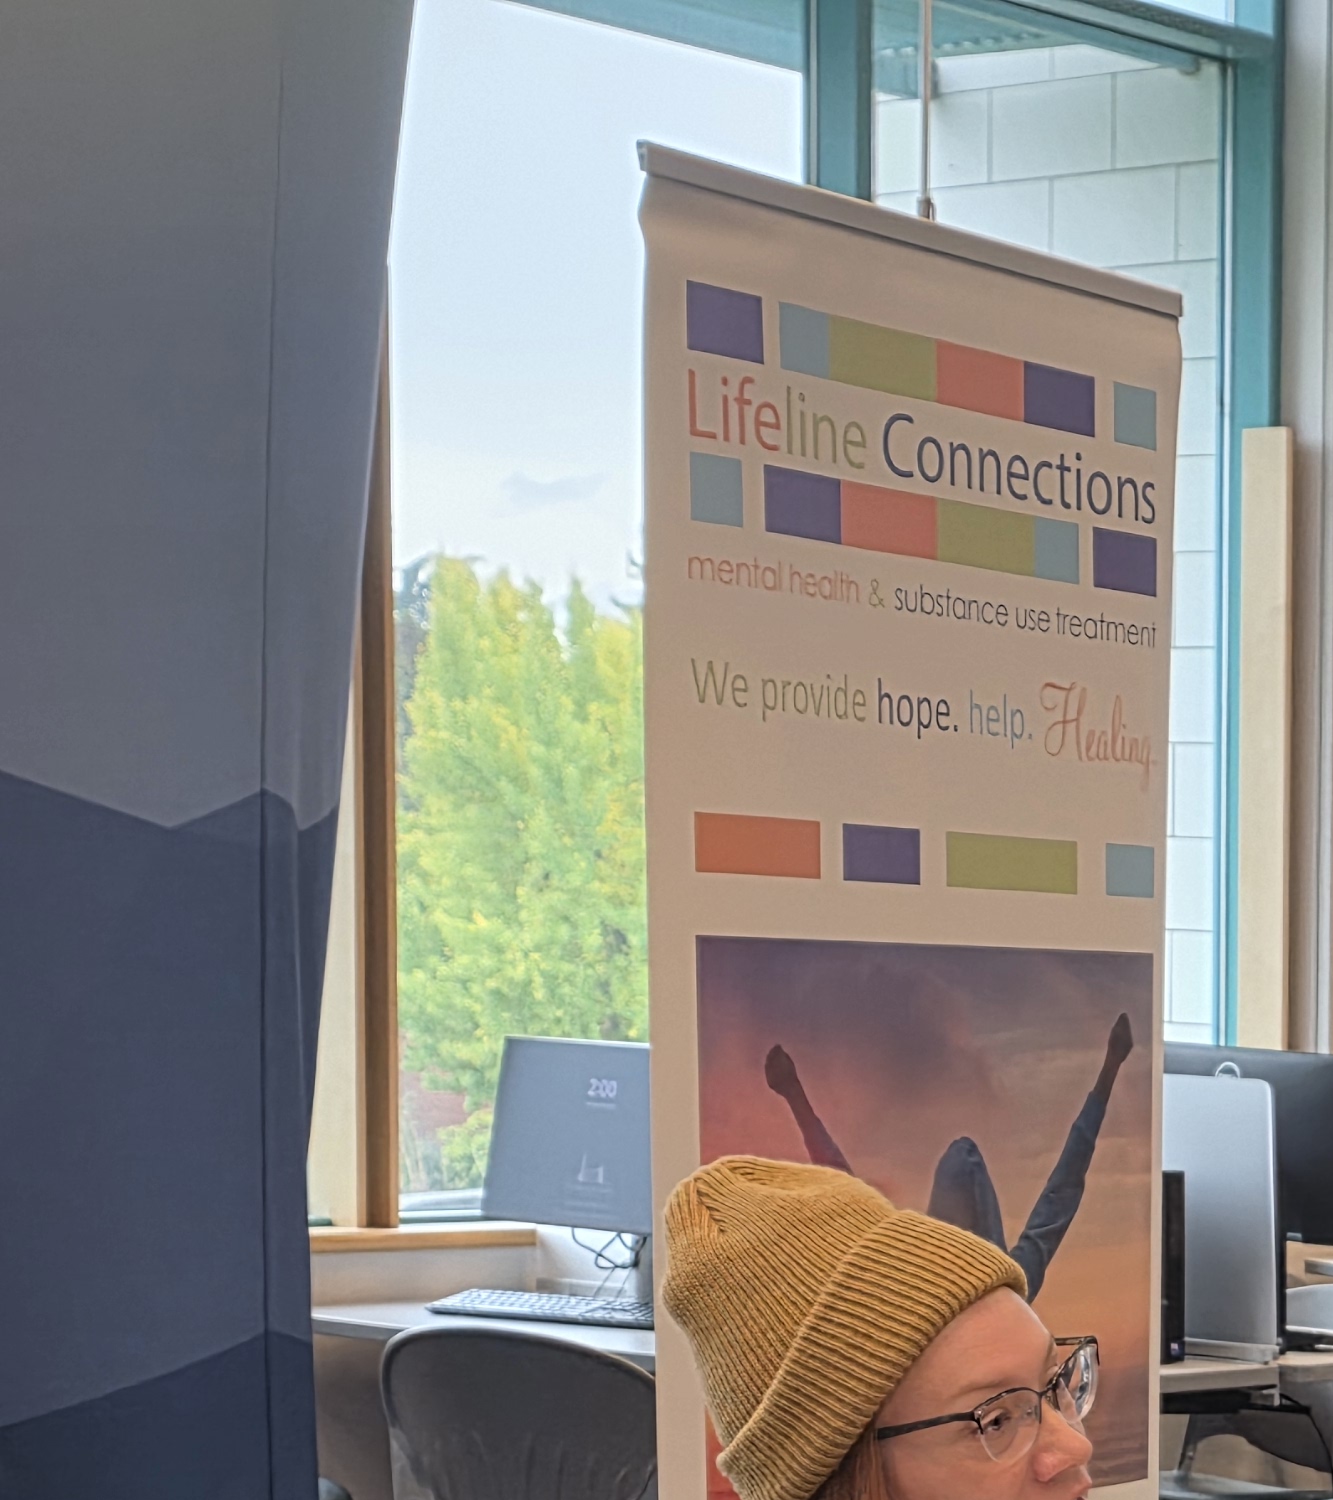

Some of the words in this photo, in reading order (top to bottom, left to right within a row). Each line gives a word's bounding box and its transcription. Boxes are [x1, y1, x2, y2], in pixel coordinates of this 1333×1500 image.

[687, 368, 867, 470] Lifeline
[882, 412, 1157, 525] Connections
[687, 554, 782, 593] mental
[789, 566, 861, 605] health
[868, 578, 885, 610] &
[894, 585, 1009, 627] substance
[1015, 607, 1051, 634] use
[1056, 606, 1157, 648] treatment
[690, 656, 749, 706] We
[760, 674, 867, 723] provide
[876, 677, 960, 740] hope.
[968, 690, 1033, 750] help.
[587, 1078, 618, 1099] 2:00
